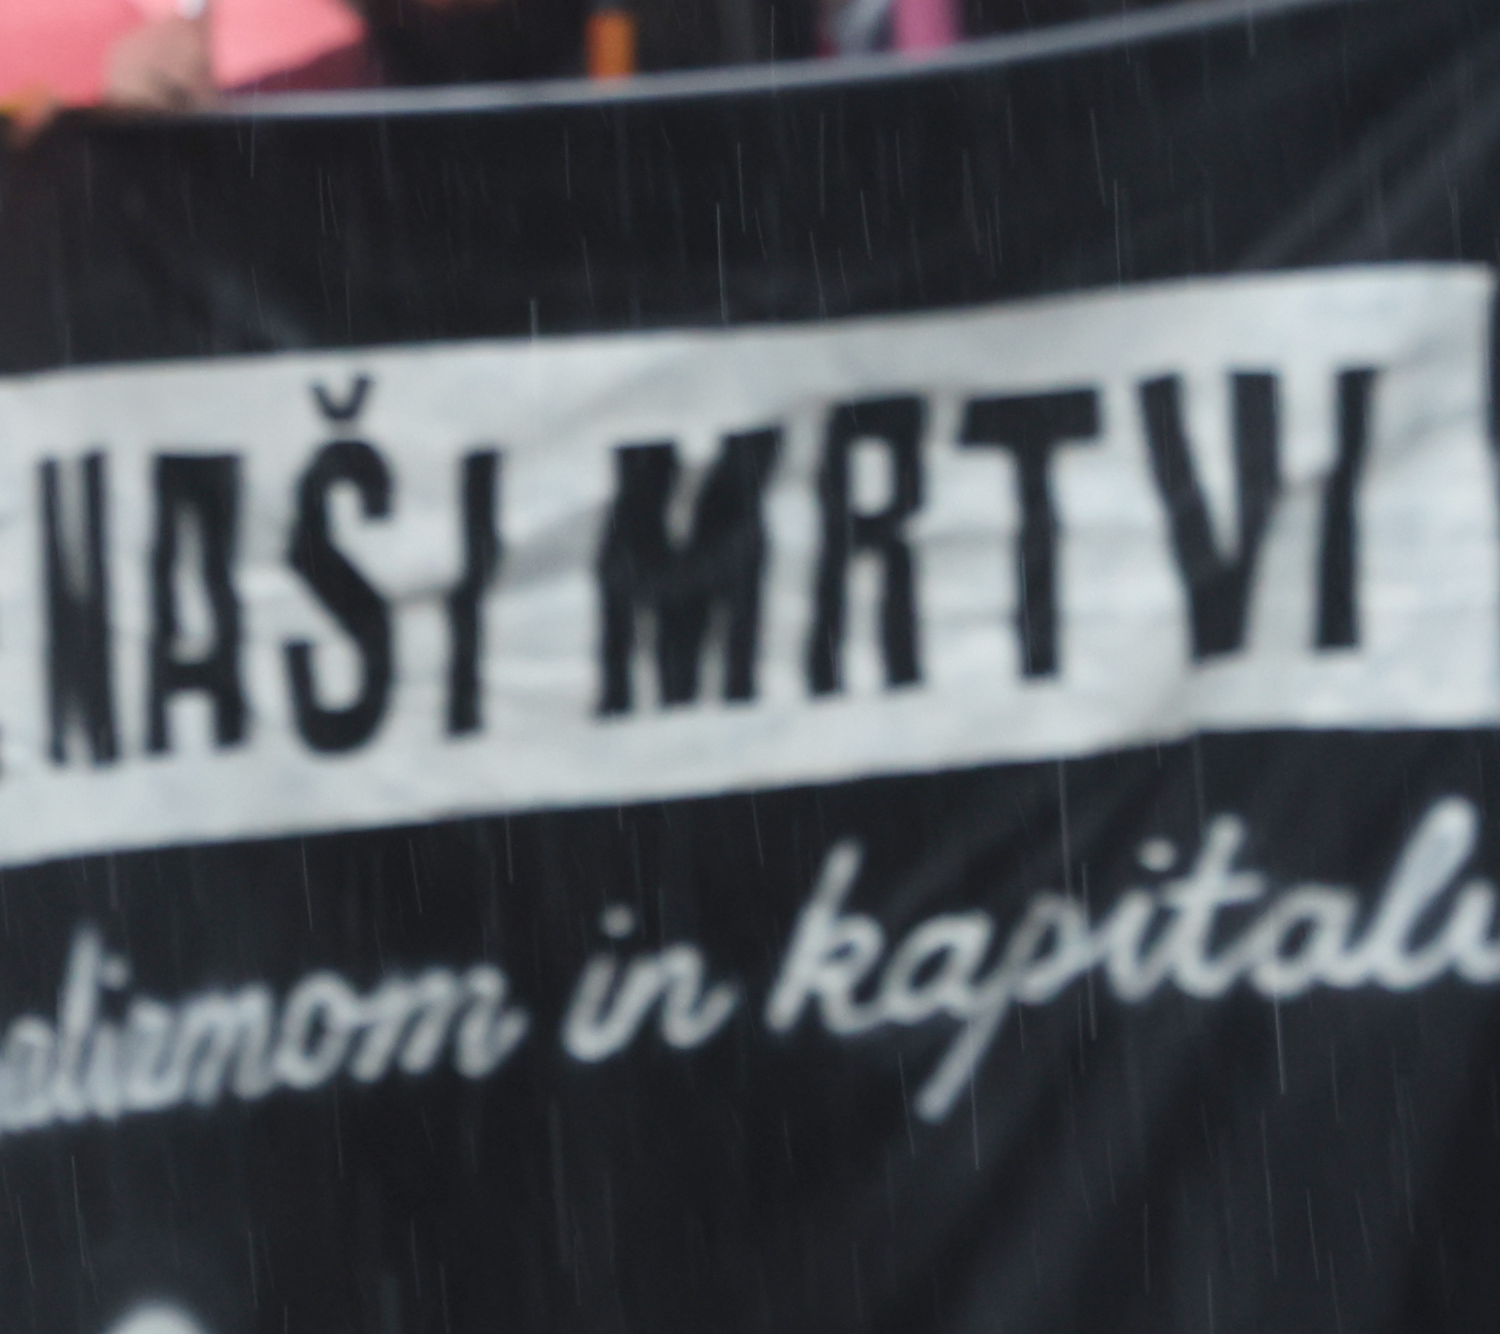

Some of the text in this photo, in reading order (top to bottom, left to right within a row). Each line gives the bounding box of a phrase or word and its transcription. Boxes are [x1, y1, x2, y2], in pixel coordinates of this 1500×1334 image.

[36, 373, 504, 767] NAŠI
[594, 364, 1386, 721] MRTVI
[562, 903, 740, 1065] in
